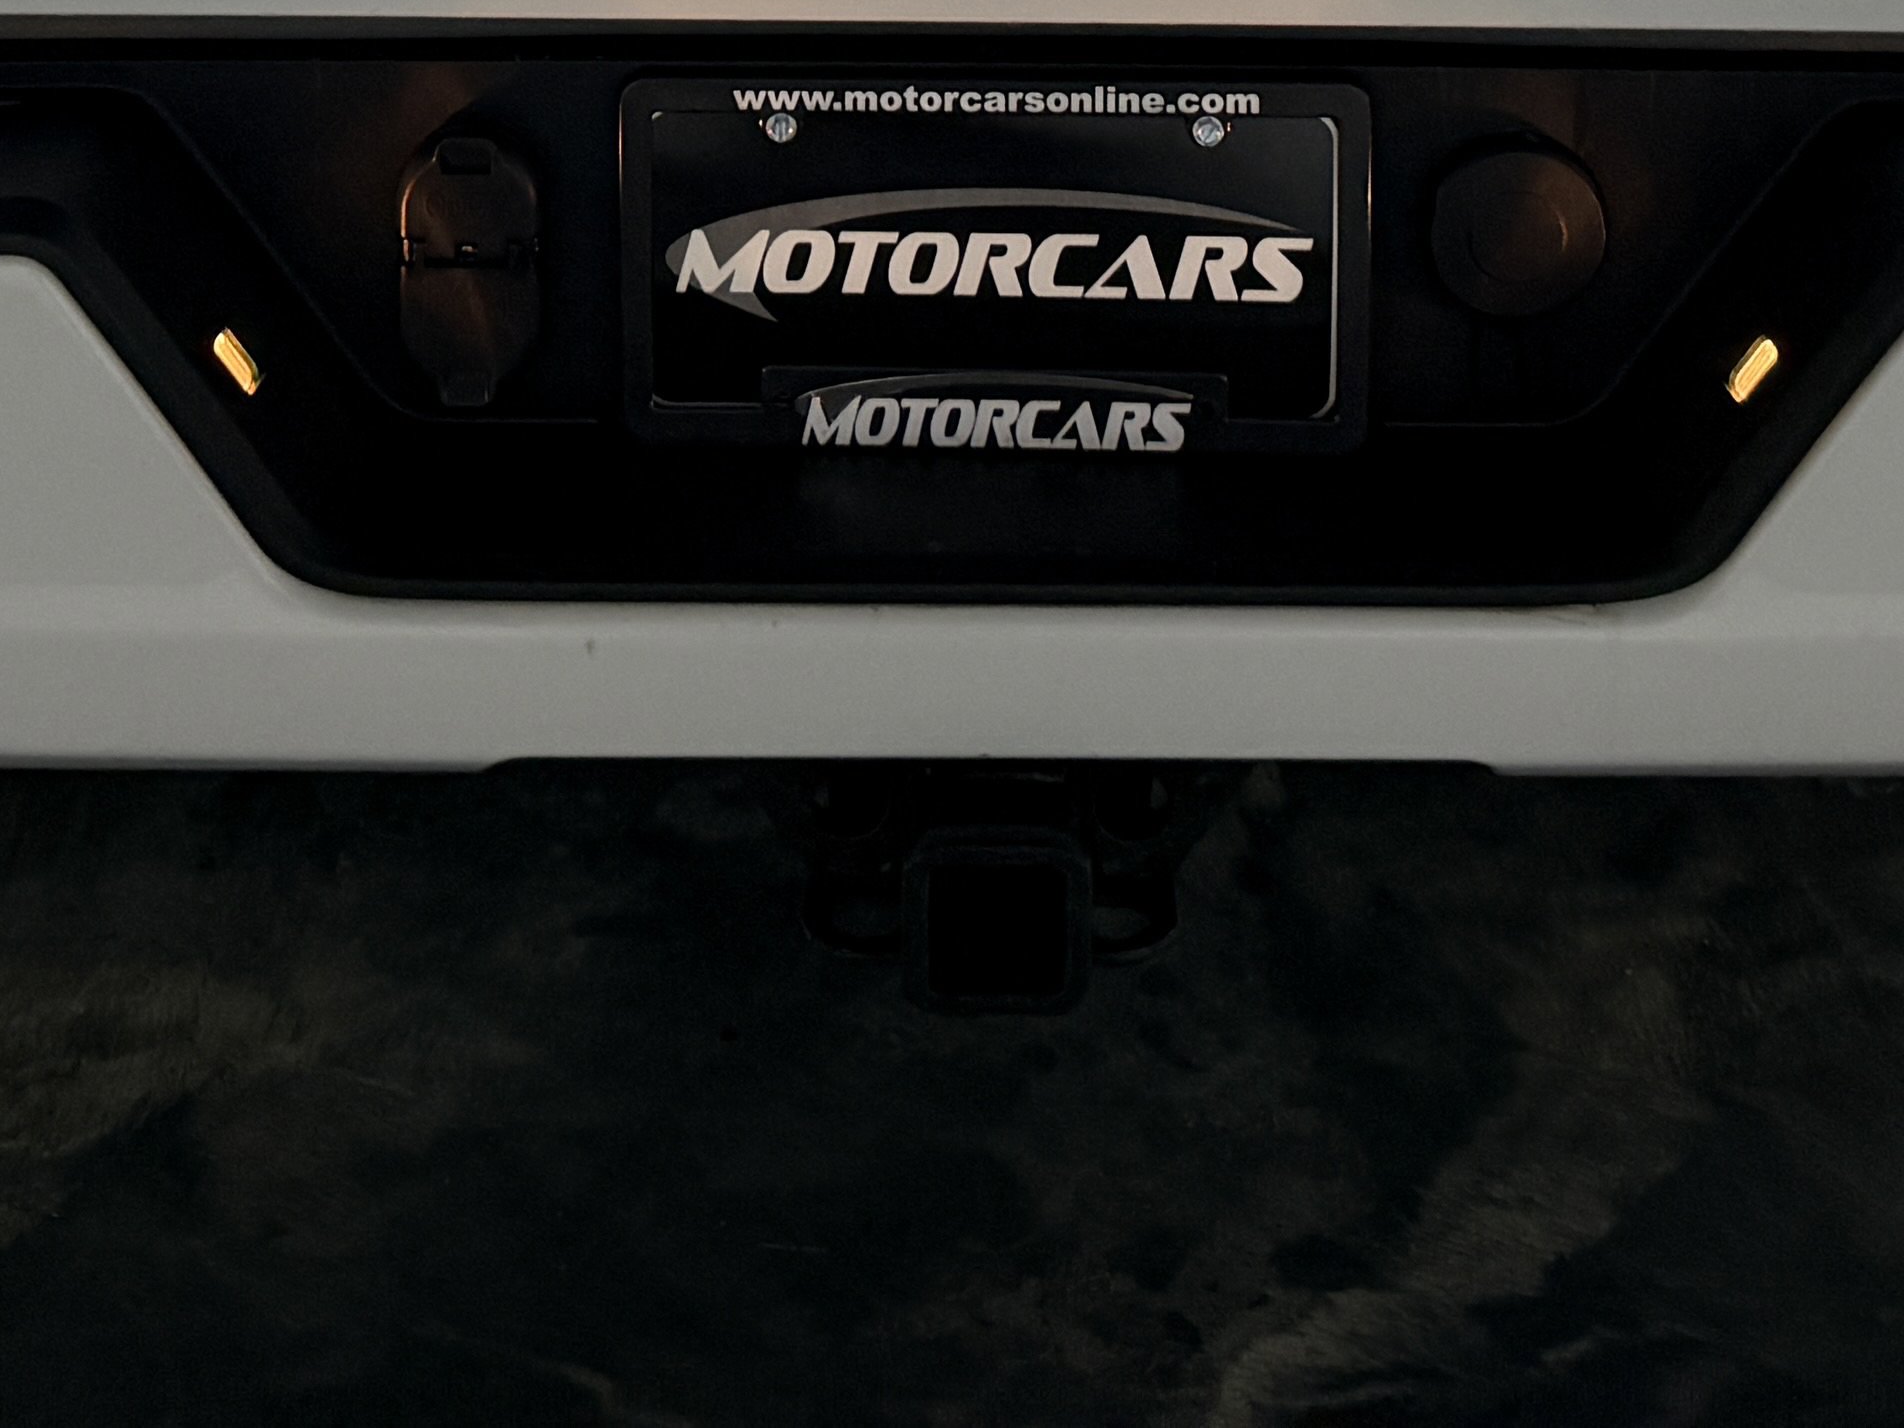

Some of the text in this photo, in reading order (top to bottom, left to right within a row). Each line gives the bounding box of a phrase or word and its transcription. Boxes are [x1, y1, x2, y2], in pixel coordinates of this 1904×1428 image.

[732, 85, 1261, 115] www.motorcarsonline.com
[675, 228, 1314, 303] MOTORCARS
[801, 395, 1193, 451] MOTORCARS
